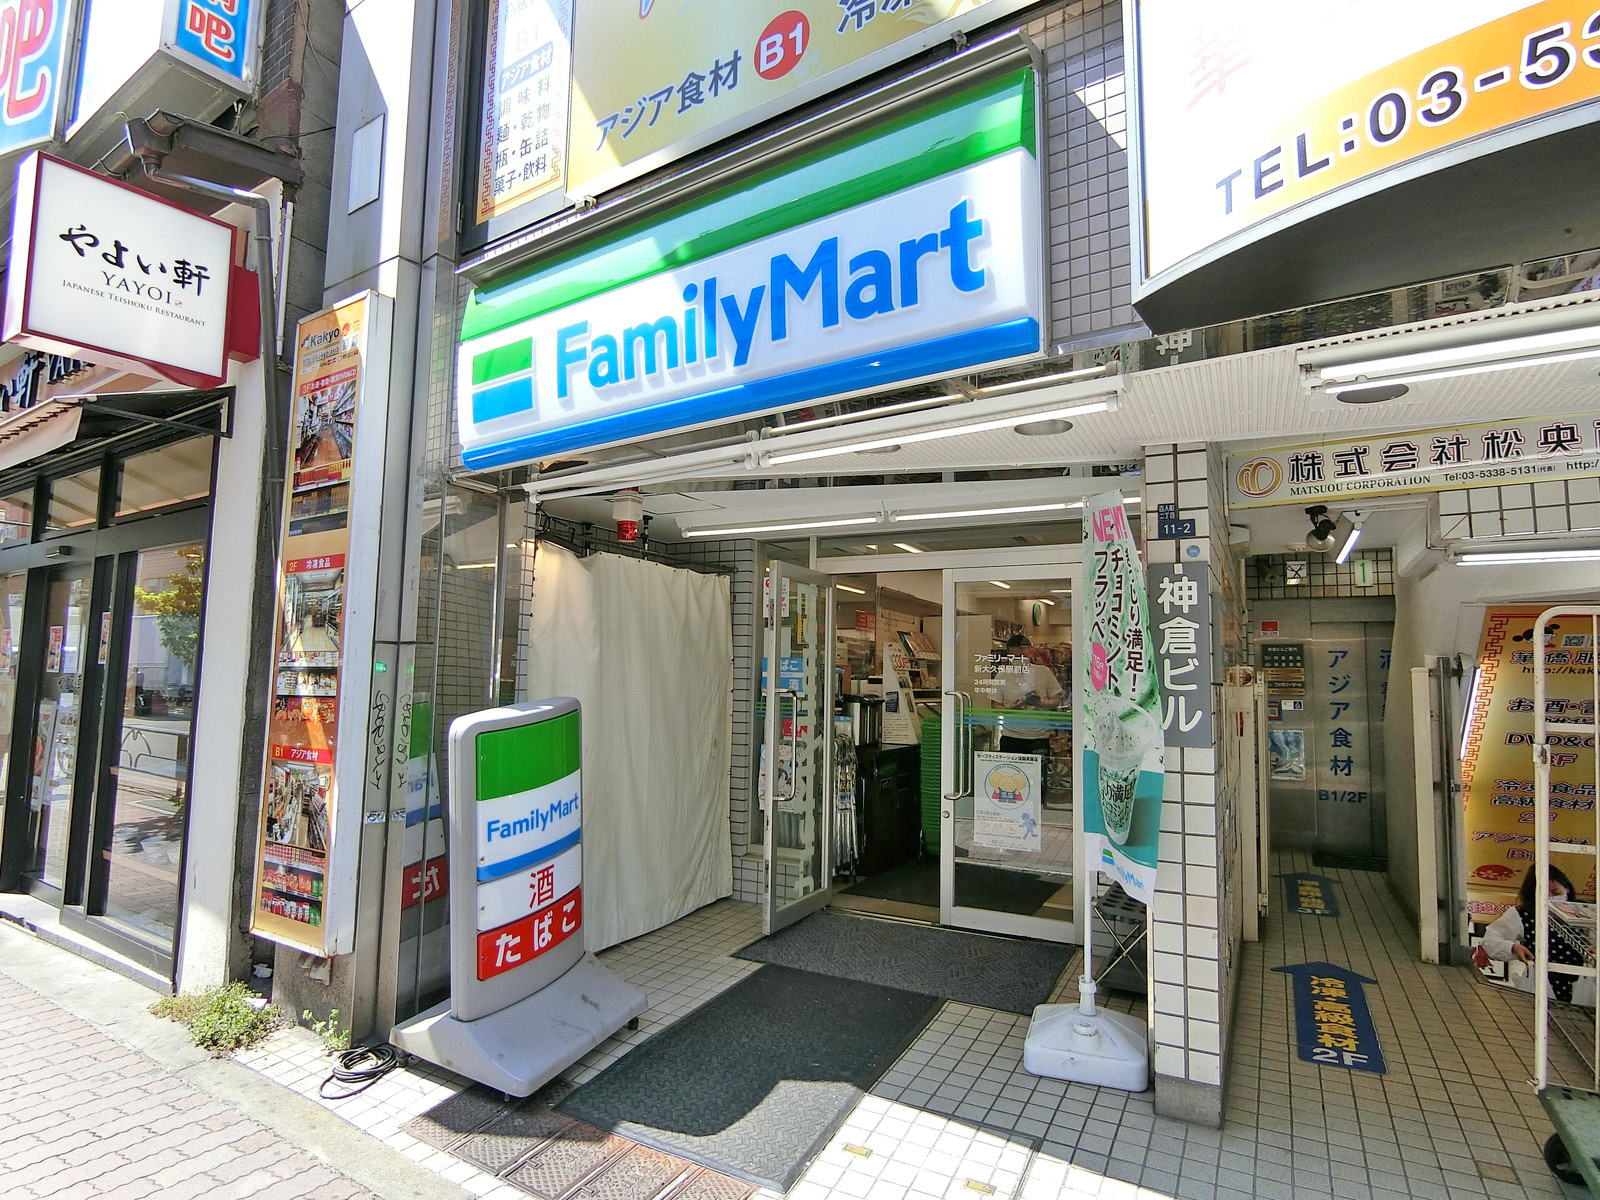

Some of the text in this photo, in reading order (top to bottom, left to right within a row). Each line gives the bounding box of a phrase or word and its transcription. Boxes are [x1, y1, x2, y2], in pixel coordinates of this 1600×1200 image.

[501, 47, 553, 92] アジア食材
[757, 21, 806, 73] B1
[595, 49, 742, 152] アジア食材
[493, 154, 548, 198] 菓子・飲料
[59, 224, 210, 297] やよい軒
[102, 271, 172, 305] YAYOI
[556, 203, 986, 400] FamilyMart
[310, 327, 340, 348] Kakyo
[1289, 422, 1600, 484] 株式会社松央
[1290, 475, 1431, 496] MATSUOU CORPORATION
[1160, 512, 1175, 520] 二丁目
[1163, 523, 1191, 535] 11-2
[289, 561, 298, 572] 2F
[1091, 550, 1109, 640] フラッペ
[1106, 548, 1124, 691] チョコミント
[974, 654, 1029, 663] ファミリーマート
[1156, 576, 1203, 733] 神倉ビル
[1328, 649, 1354, 777] アジア食材
[275, 747, 319, 761] B1 アジア食材
[487, 793, 579, 842] FamilyMart
[1318, 789, 1367, 803] B1/2F
[529, 864, 555, 909] 酒
[495, 899, 576, 967] たばこ
[1312, 1048, 1369, 1066] 2F
